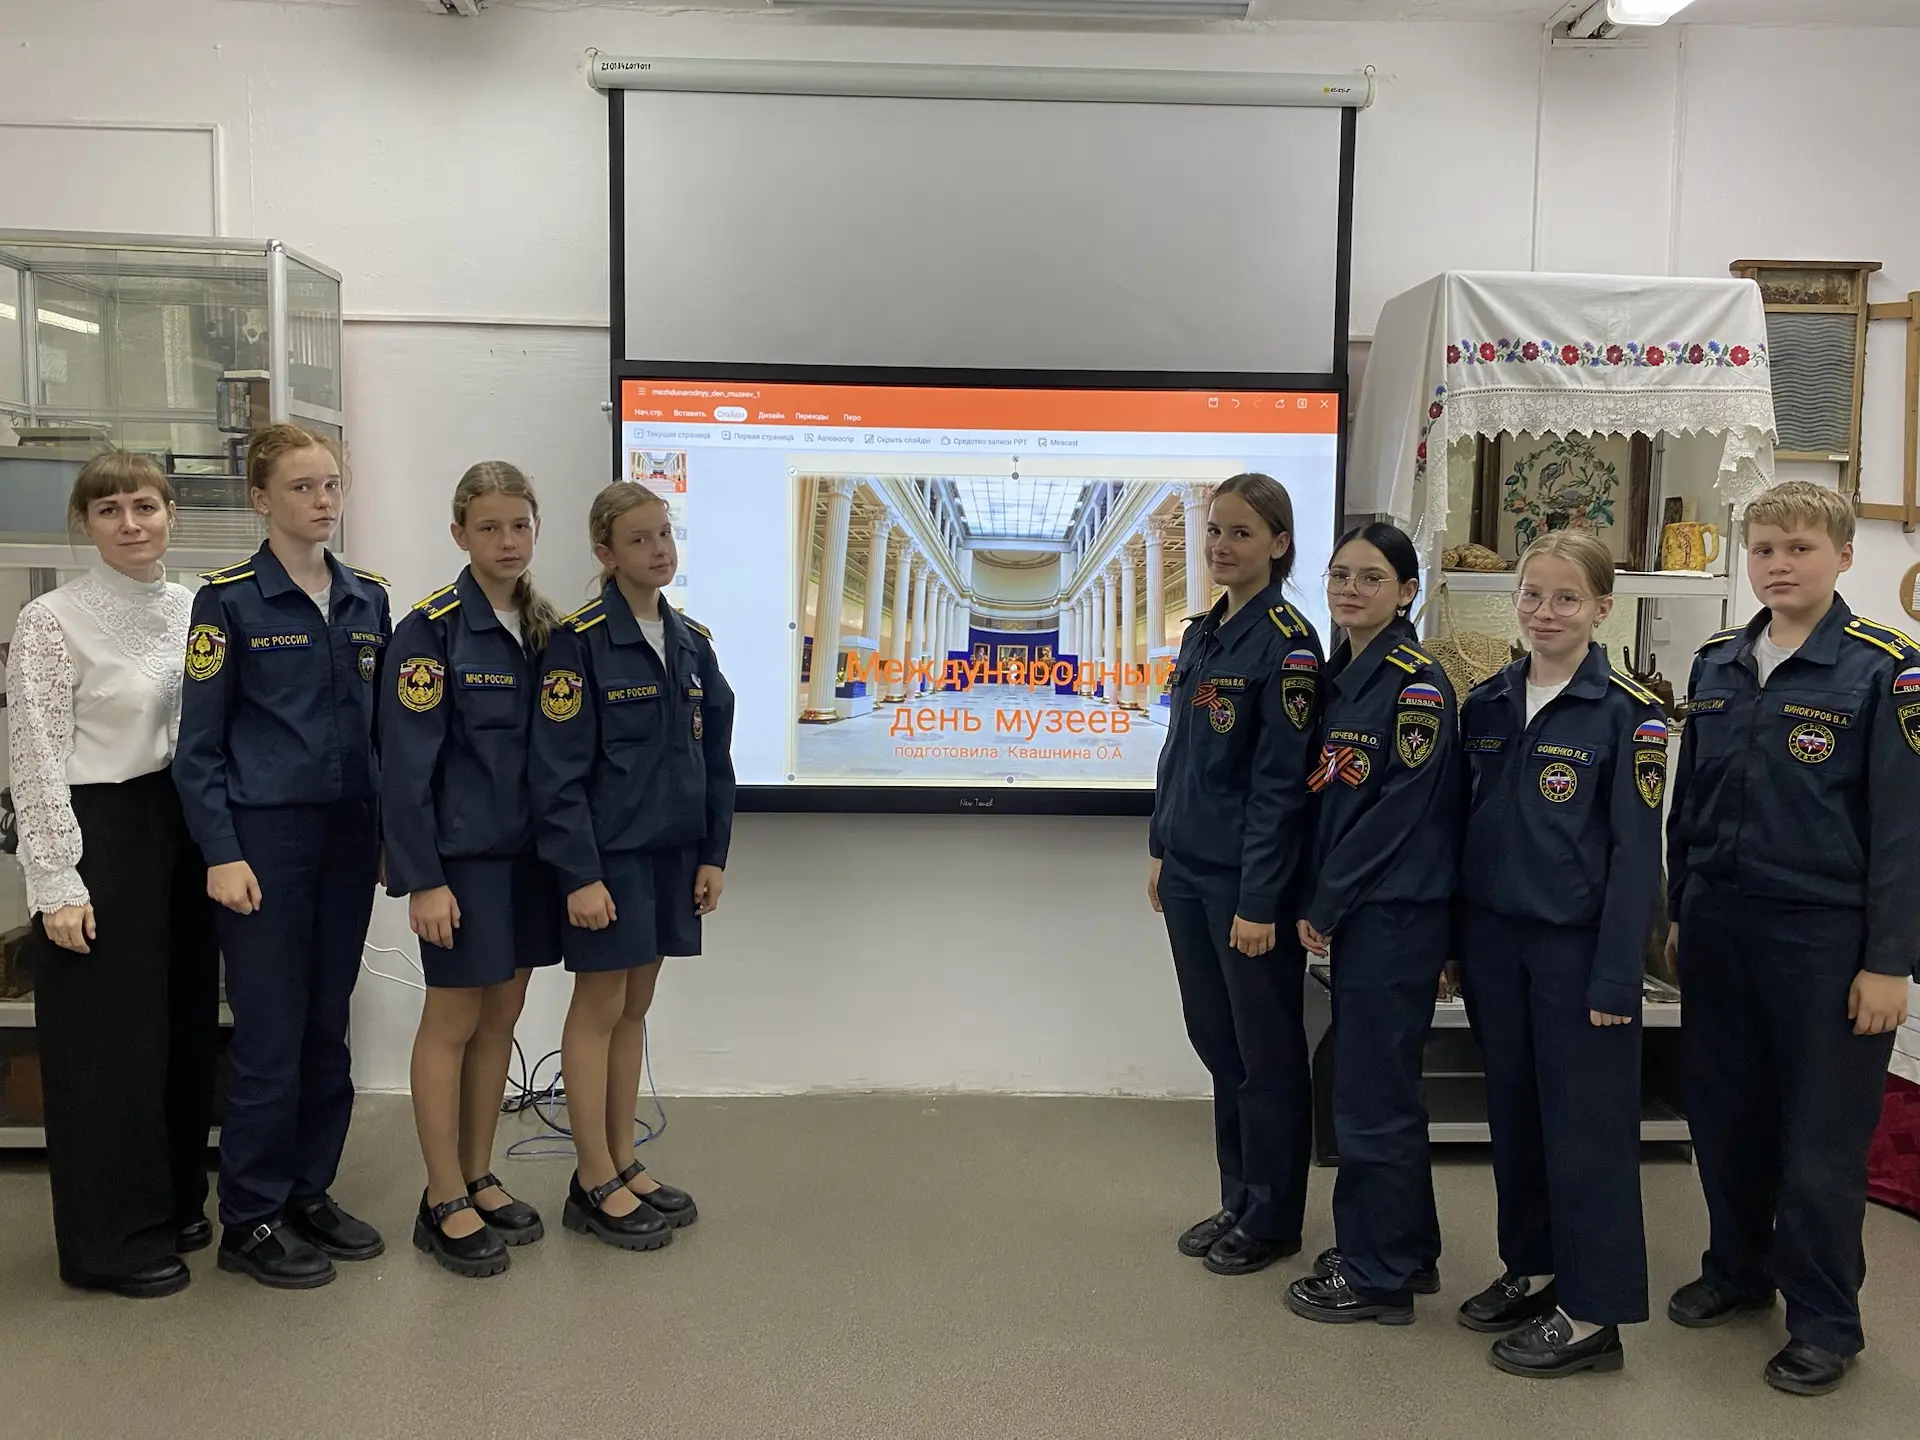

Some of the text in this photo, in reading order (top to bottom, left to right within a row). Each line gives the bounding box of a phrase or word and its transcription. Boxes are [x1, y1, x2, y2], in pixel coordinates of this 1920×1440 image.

[673, 409, 707, 418] Вставить
[757, 411, 785, 420] Дизайн
[795, 412, 829, 421] Переходы
[843, 413, 862, 423] Перо
[646, 430, 711, 440] Текущая страница
[734, 433, 795, 442] Первая страница
[876, 436, 931, 445] Скрыть слайды
[953, 437, 987, 446] Средство
[251, 634, 309, 648] МЧС РОССИИ
[846, 650, 1176, 692] Международный
[465, 673, 514, 685] МЧС РОССИИ
[607, 685, 658, 701] МЧС РОССИИ
[1405, 698, 1436, 706] RUSSIA
[1783, 704, 1832, 721] ВИНОКУРОВ
[890, 706, 1131, 742] день музеев
[1007, 745, 1091, 760] Квашнина
[1536, 745, 1574, 757] ФОМЕНКО
